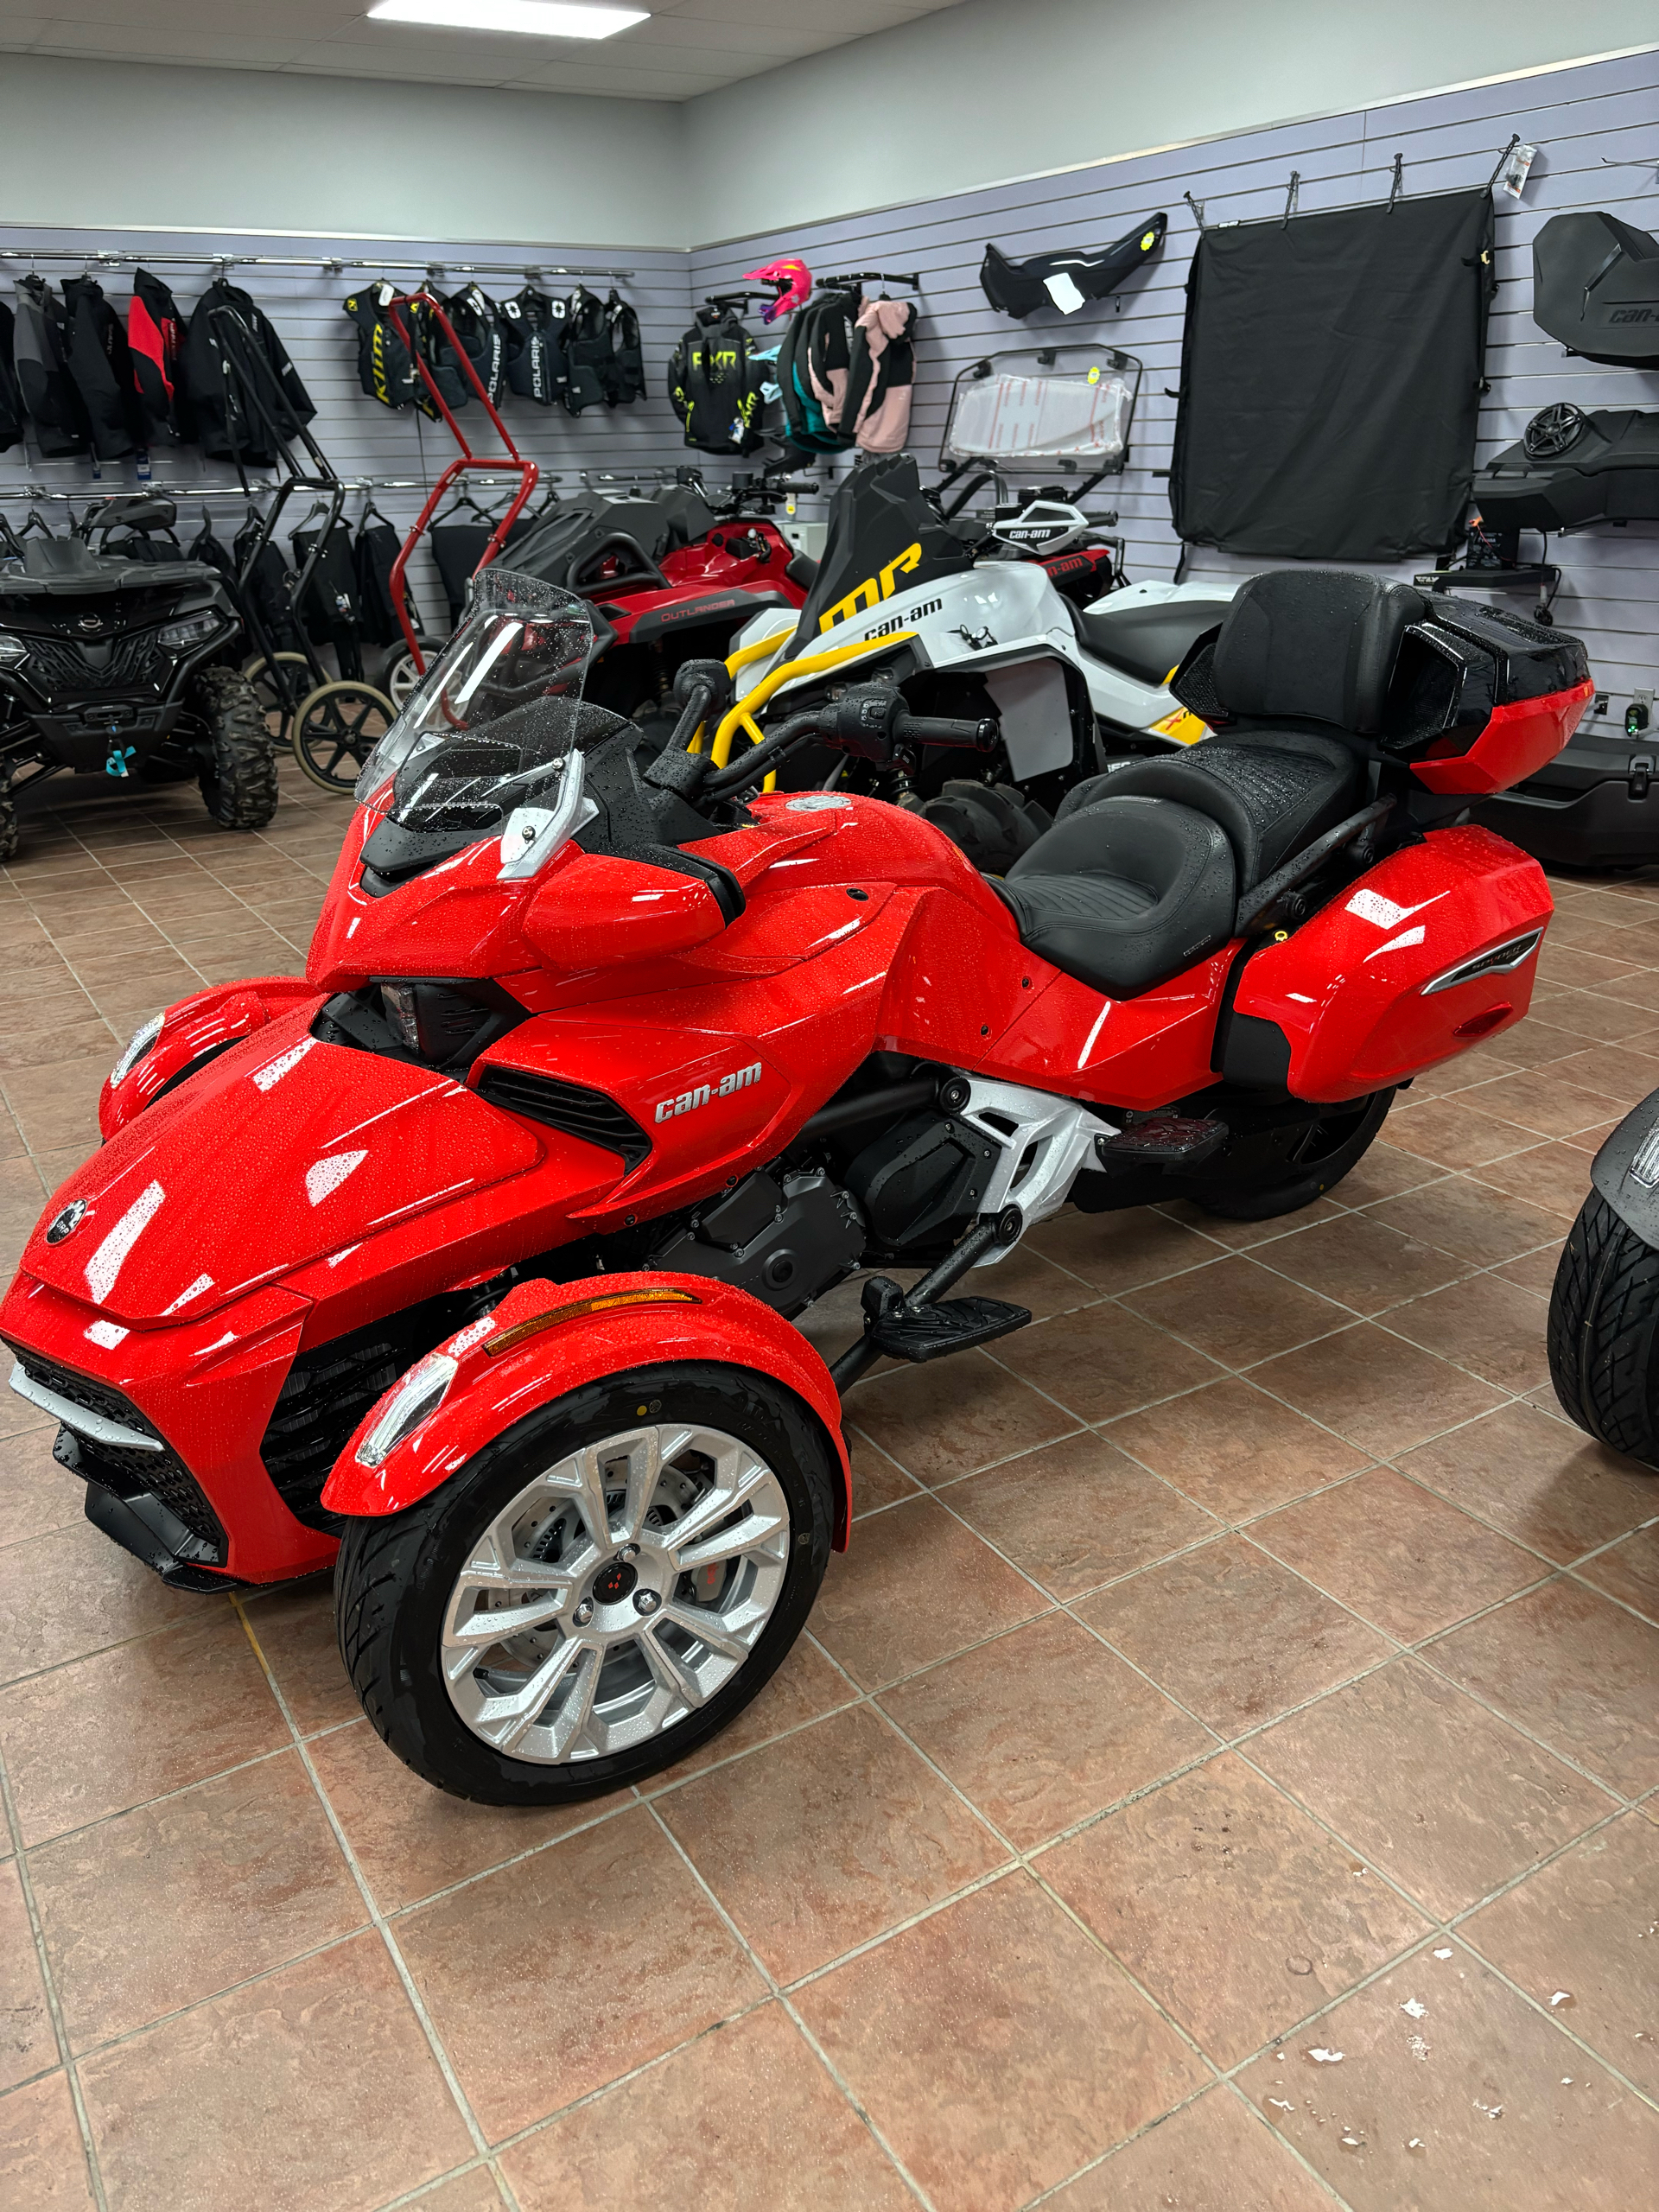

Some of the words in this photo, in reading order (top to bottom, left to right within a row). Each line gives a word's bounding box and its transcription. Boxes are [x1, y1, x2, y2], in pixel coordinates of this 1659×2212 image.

[487, 334, 501, 404] POLARIS
[531, 334, 543, 398] POLARIS
[1008, 529, 1052, 539] can-am
[1047, 557, 1084, 577] n-am
[661, 599, 735, 622] OUTLANDER
[864, 598, 943, 642] can-am
[654, 1061, 762, 1123] can-am
[56, 1220, 70, 1234] BRP
